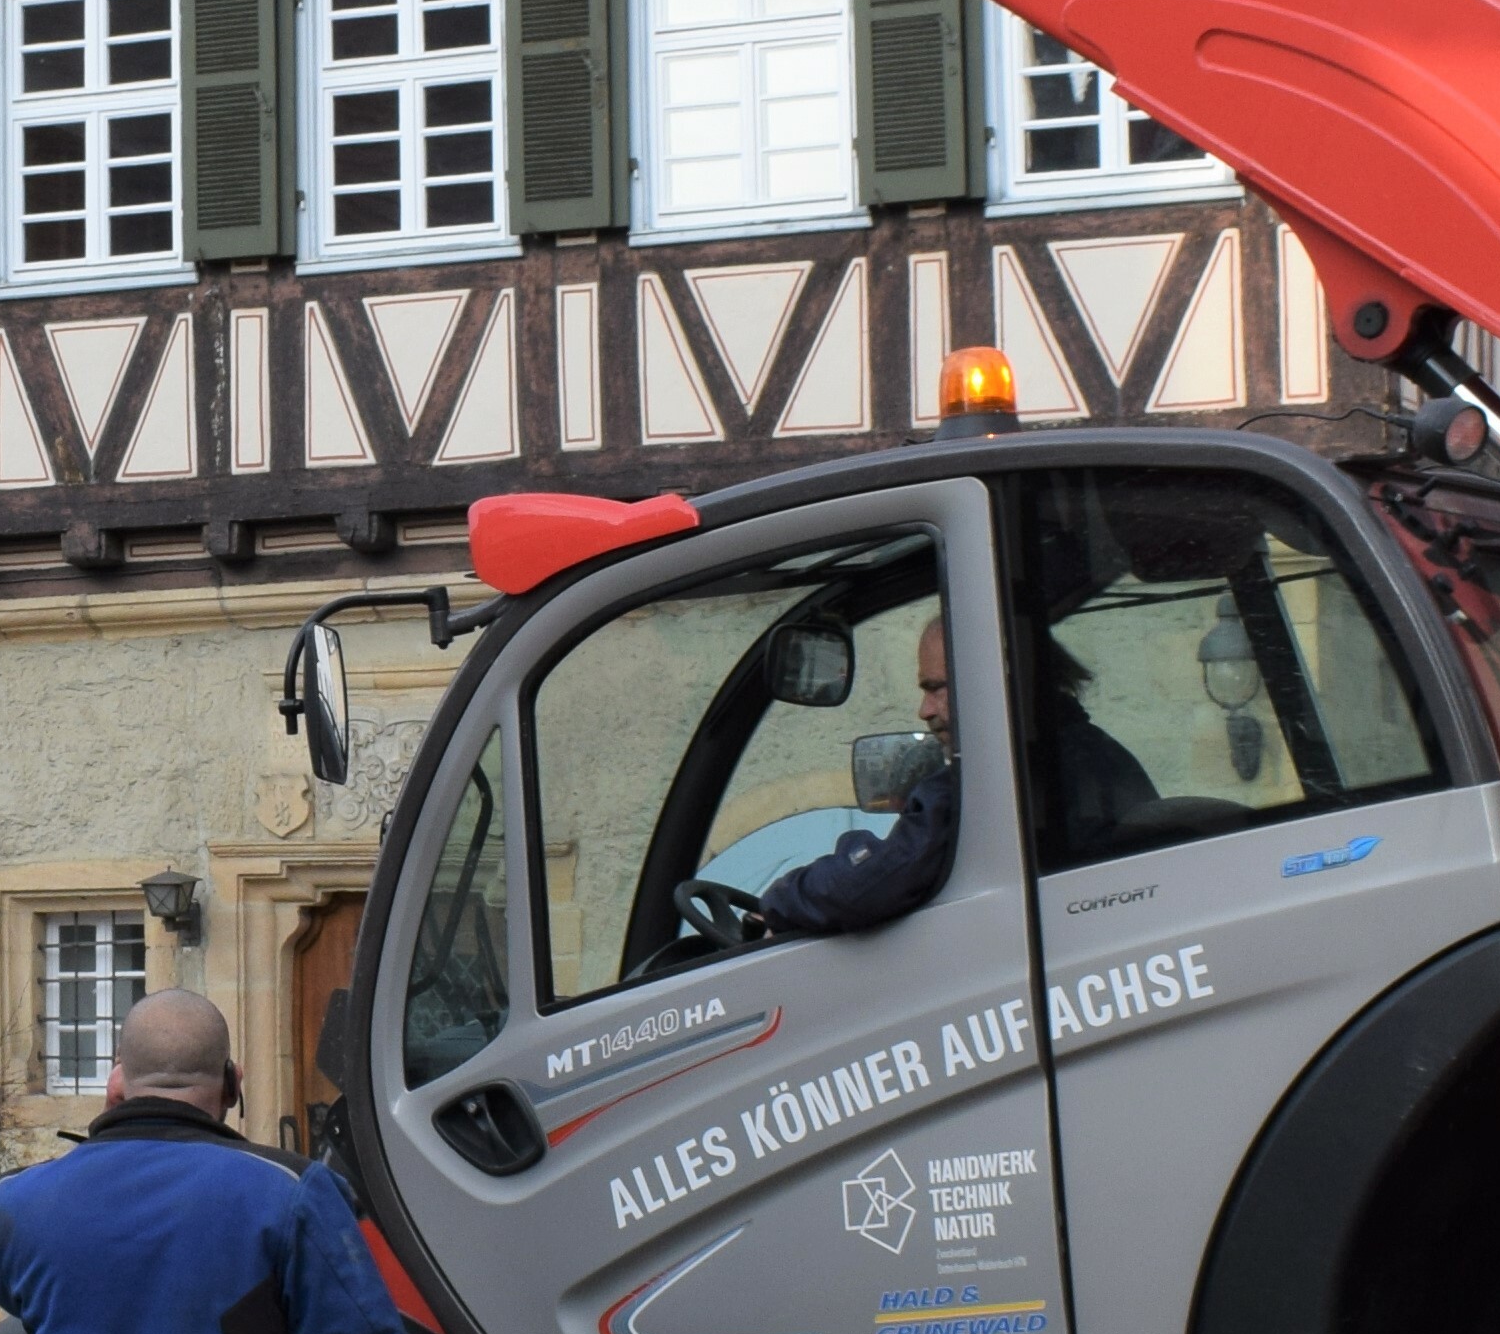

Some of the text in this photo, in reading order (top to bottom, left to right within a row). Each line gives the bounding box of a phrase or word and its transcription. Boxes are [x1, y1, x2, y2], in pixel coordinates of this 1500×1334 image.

[1066, 884, 1159, 915] COMFORT
[608, 944, 1214, 1229] ALLES KÖNNER AUF ACHSE
[928, 1149, 1038, 1184] HANDWERK
[929, 1181, 1012, 1213] TECHNIK
[934, 1212, 996, 1241] NATUR
[880, 1285, 982, 1310] HALD &
